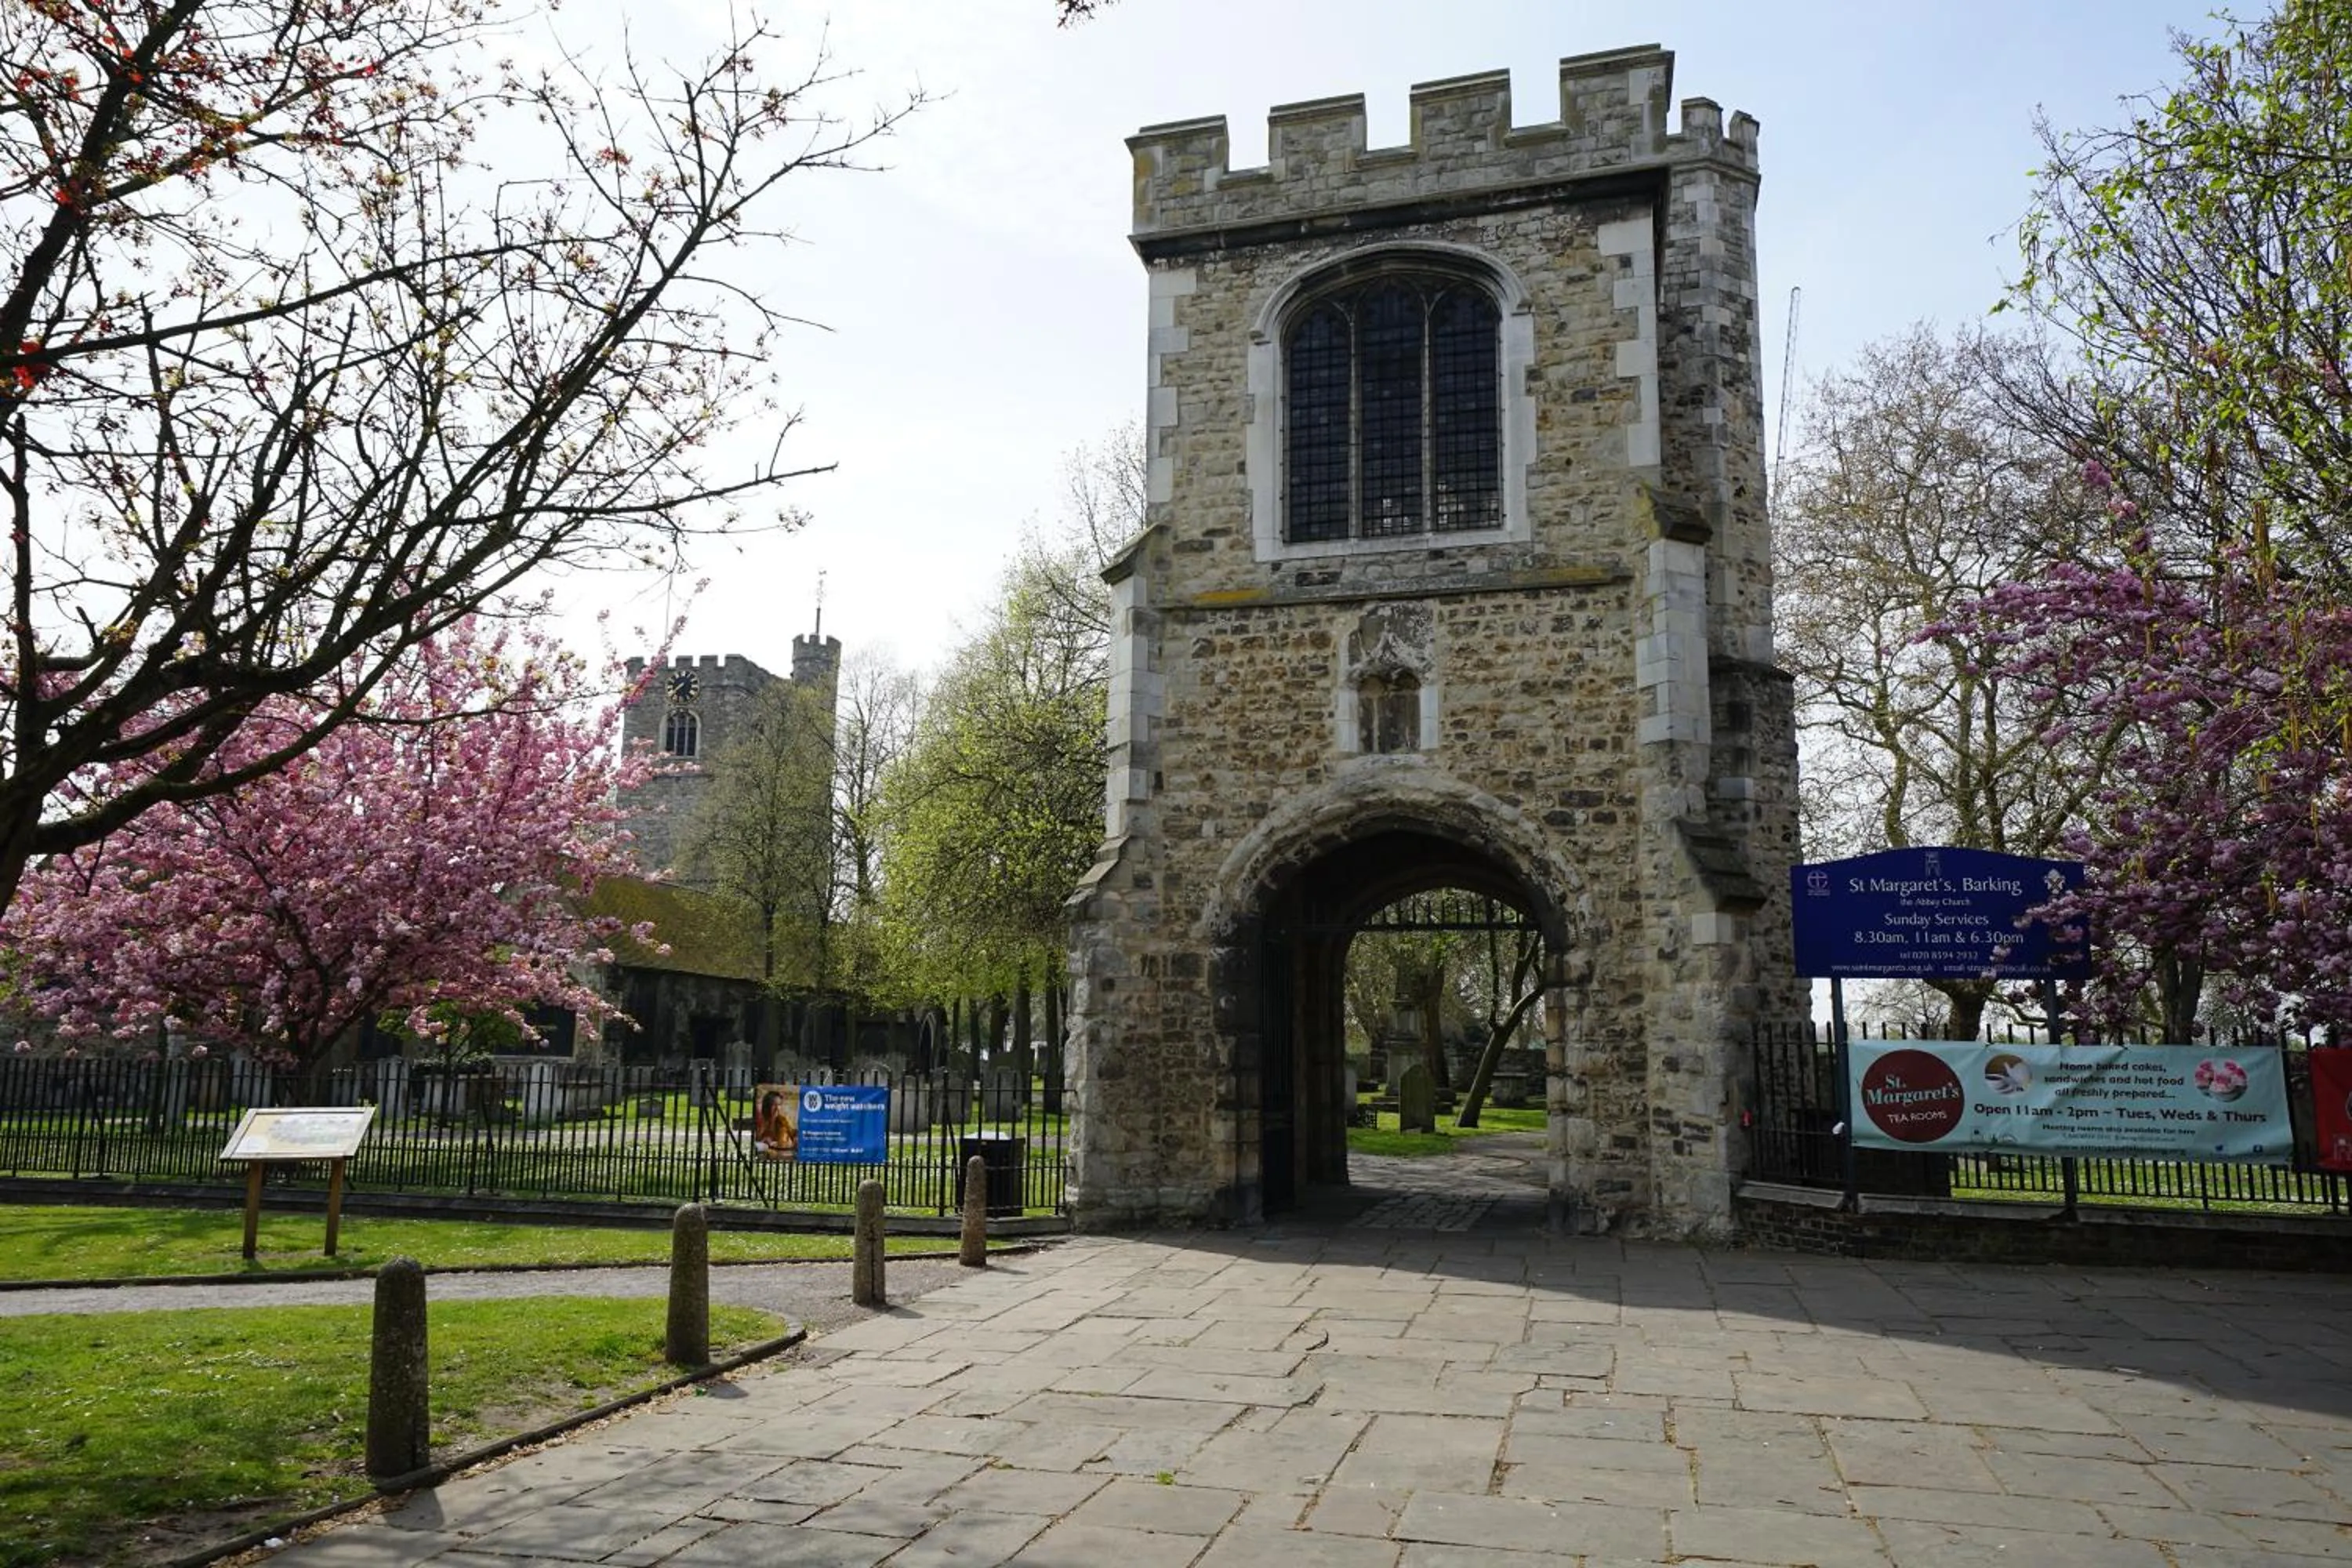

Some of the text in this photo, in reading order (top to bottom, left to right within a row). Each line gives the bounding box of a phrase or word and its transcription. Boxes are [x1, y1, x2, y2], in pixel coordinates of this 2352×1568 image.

[1849, 877, 2022, 897] St Margaret's, Barking
[1942, 898, 1970, 906] Church
[1884, 913, 1989, 928] Sunday Services
[1854, 931, 2024, 946] 8.30am, 11am & 6.30pm
[1912, 950, 1929, 960] 020
[2059, 1062, 2166, 1073] Home baked cakes,
[1886, 1074, 1906, 1088] St.
[2045, 1075, 2184, 1086] sandwiches and hot food
[1867, 1082, 1959, 1106] Margaret's
[2055, 1087, 2069, 1097] all
[2071, 1087, 2109, 1098] freshly
[824, 1102, 849, 1112] weight
[1974, 1103, 2011, 1116] Open
[2016, 1105, 2053, 1116] 11am
[2067, 1106, 2099, 1120] 2pm
[2116, 1108, 2156, 1121] Tues,
[2160, 1109, 2202, 1121] Weds
[2207, 1110, 2217, 1121] &
[2223, 1111, 2267, 1122] Thurs
[1887, 1111, 1947, 1123] TEA ROOMS
